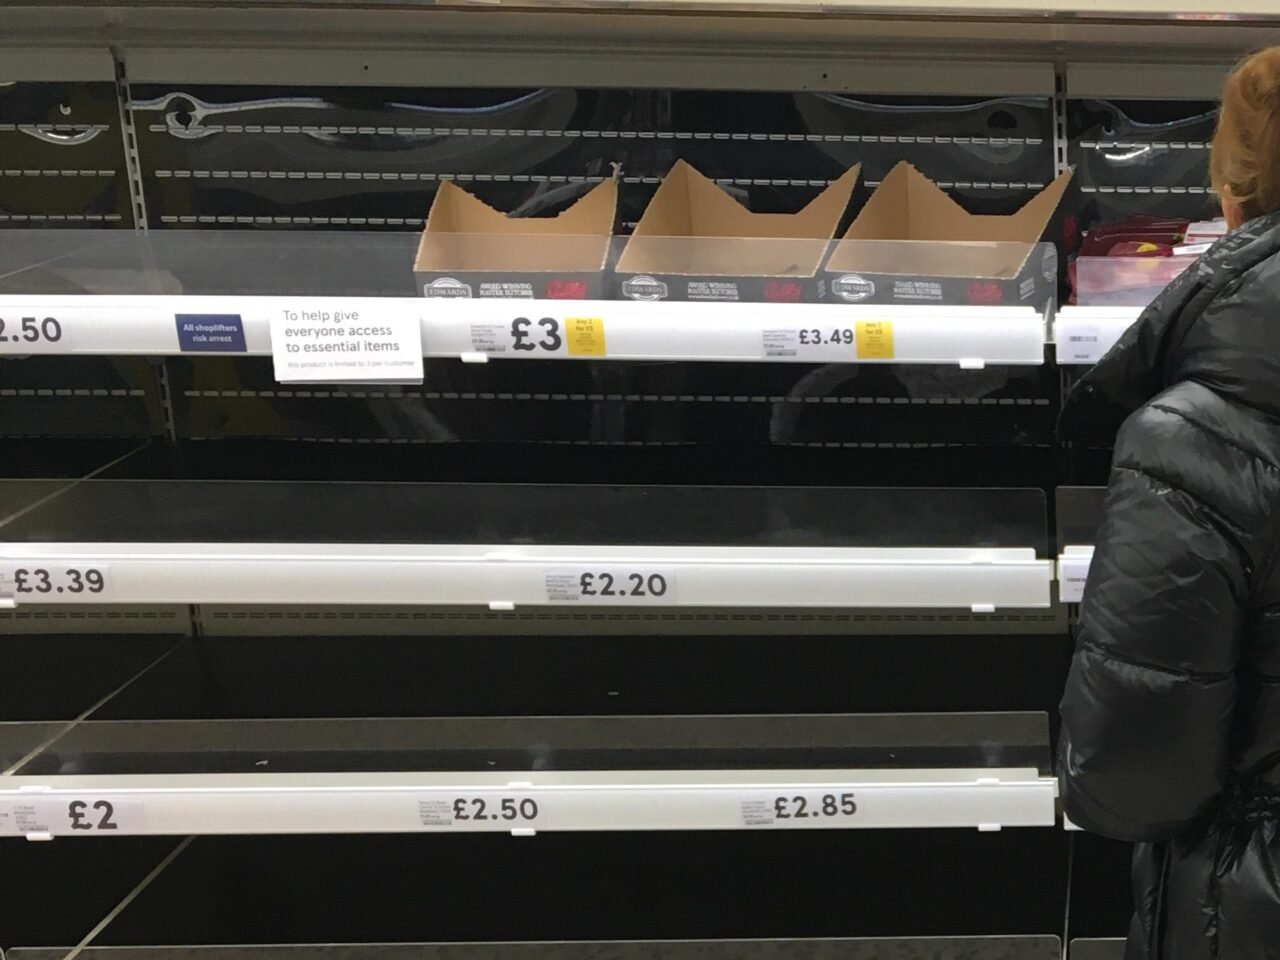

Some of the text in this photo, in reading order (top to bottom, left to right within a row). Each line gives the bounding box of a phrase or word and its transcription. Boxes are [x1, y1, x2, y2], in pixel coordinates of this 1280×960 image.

[183, 323, 238, 333] All shoplifters
[284, 310, 359, 324] To help give
[285, 326, 393, 339] everyone access
[511, 317, 562, 351] £3
[798, 329, 854, 345] £3.49
[286, 340, 400, 353] to essential items
[14, 568, 104, 593] £3.39
[580, 572, 667, 597] £2.20
[68, 800, 118, 830] £2
[453, 798, 538, 820] £2.50
[774, 793, 857, 818] £2.85
